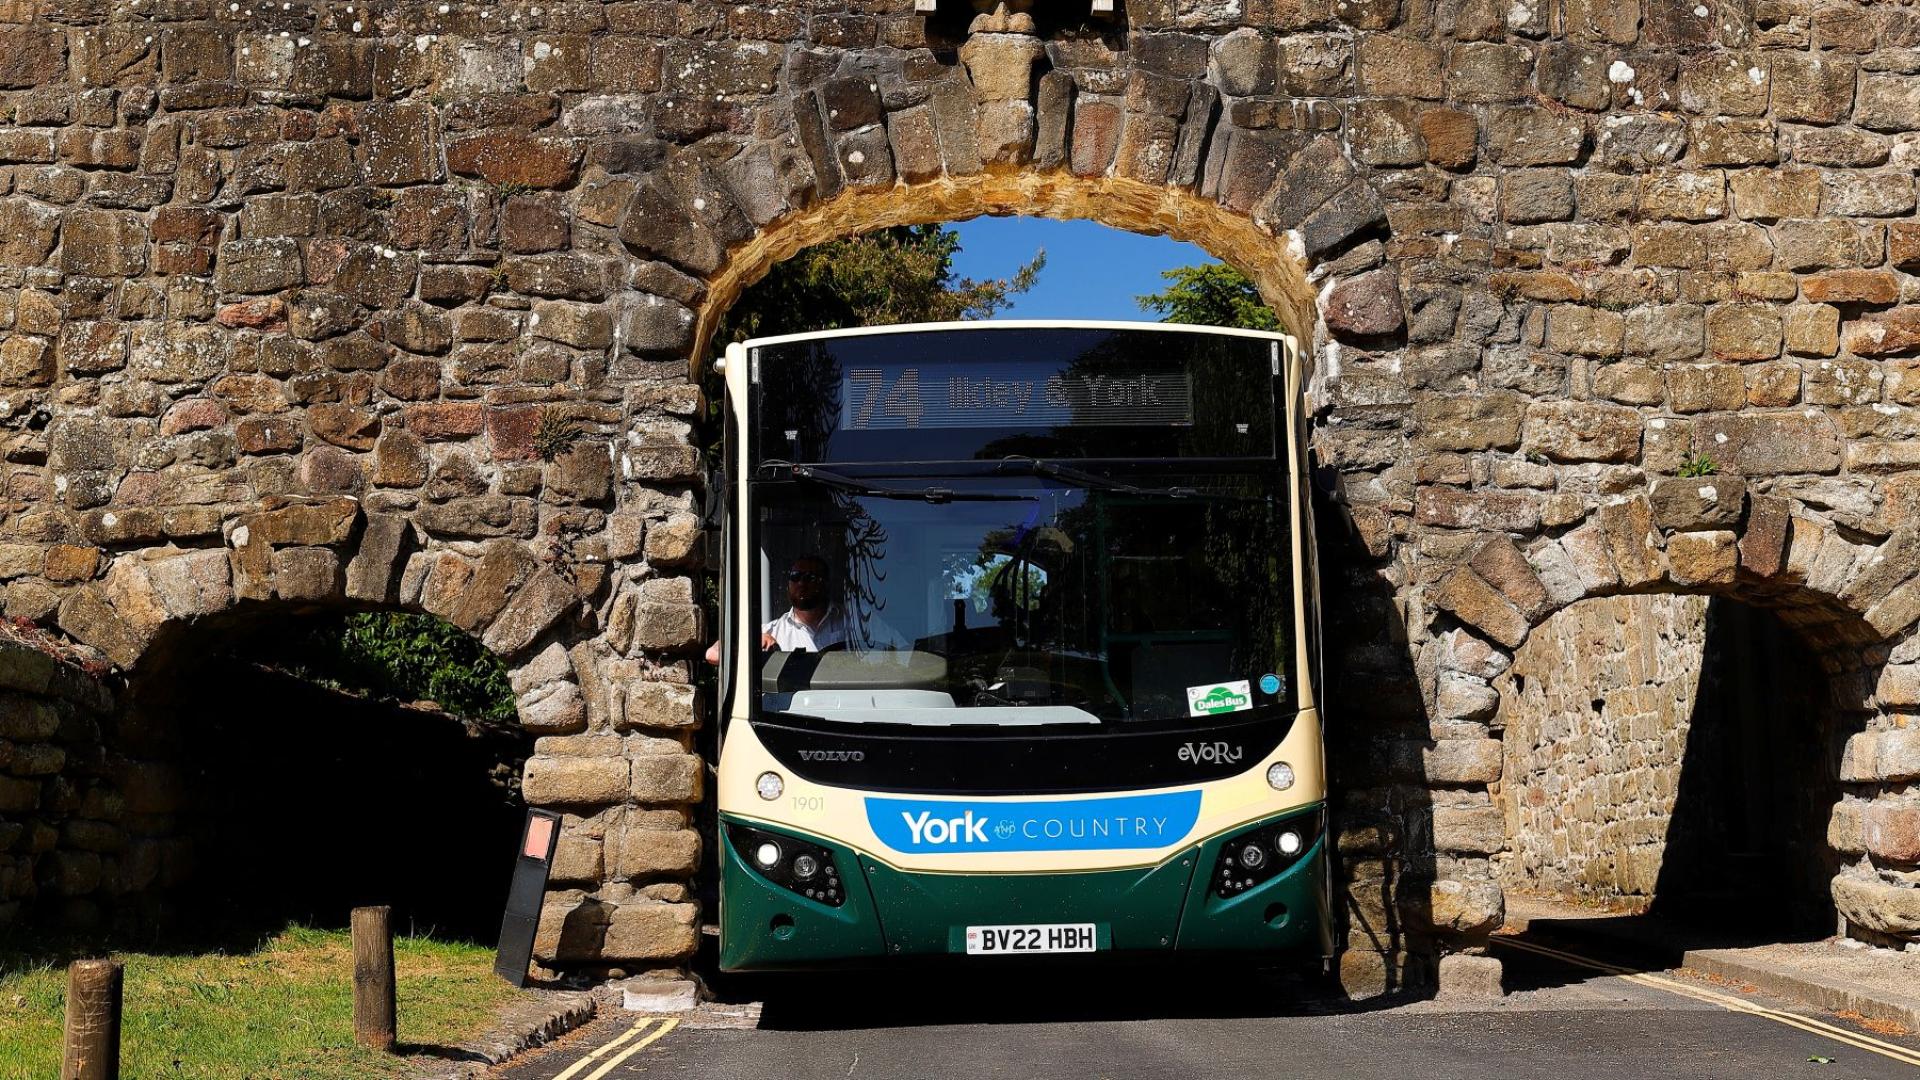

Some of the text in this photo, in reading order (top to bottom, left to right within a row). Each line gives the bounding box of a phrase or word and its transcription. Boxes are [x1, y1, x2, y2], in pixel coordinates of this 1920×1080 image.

[850, 368, 1162, 430] 74 Ilkley & York
[797, 749, 865, 762] VOLVO
[792, 796, 824, 812] 1901
[901, 810, 989, 844] York
[1022, 817, 1168, 839] COUNTRY
[981, 927, 1093, 951] BV22 HBH
